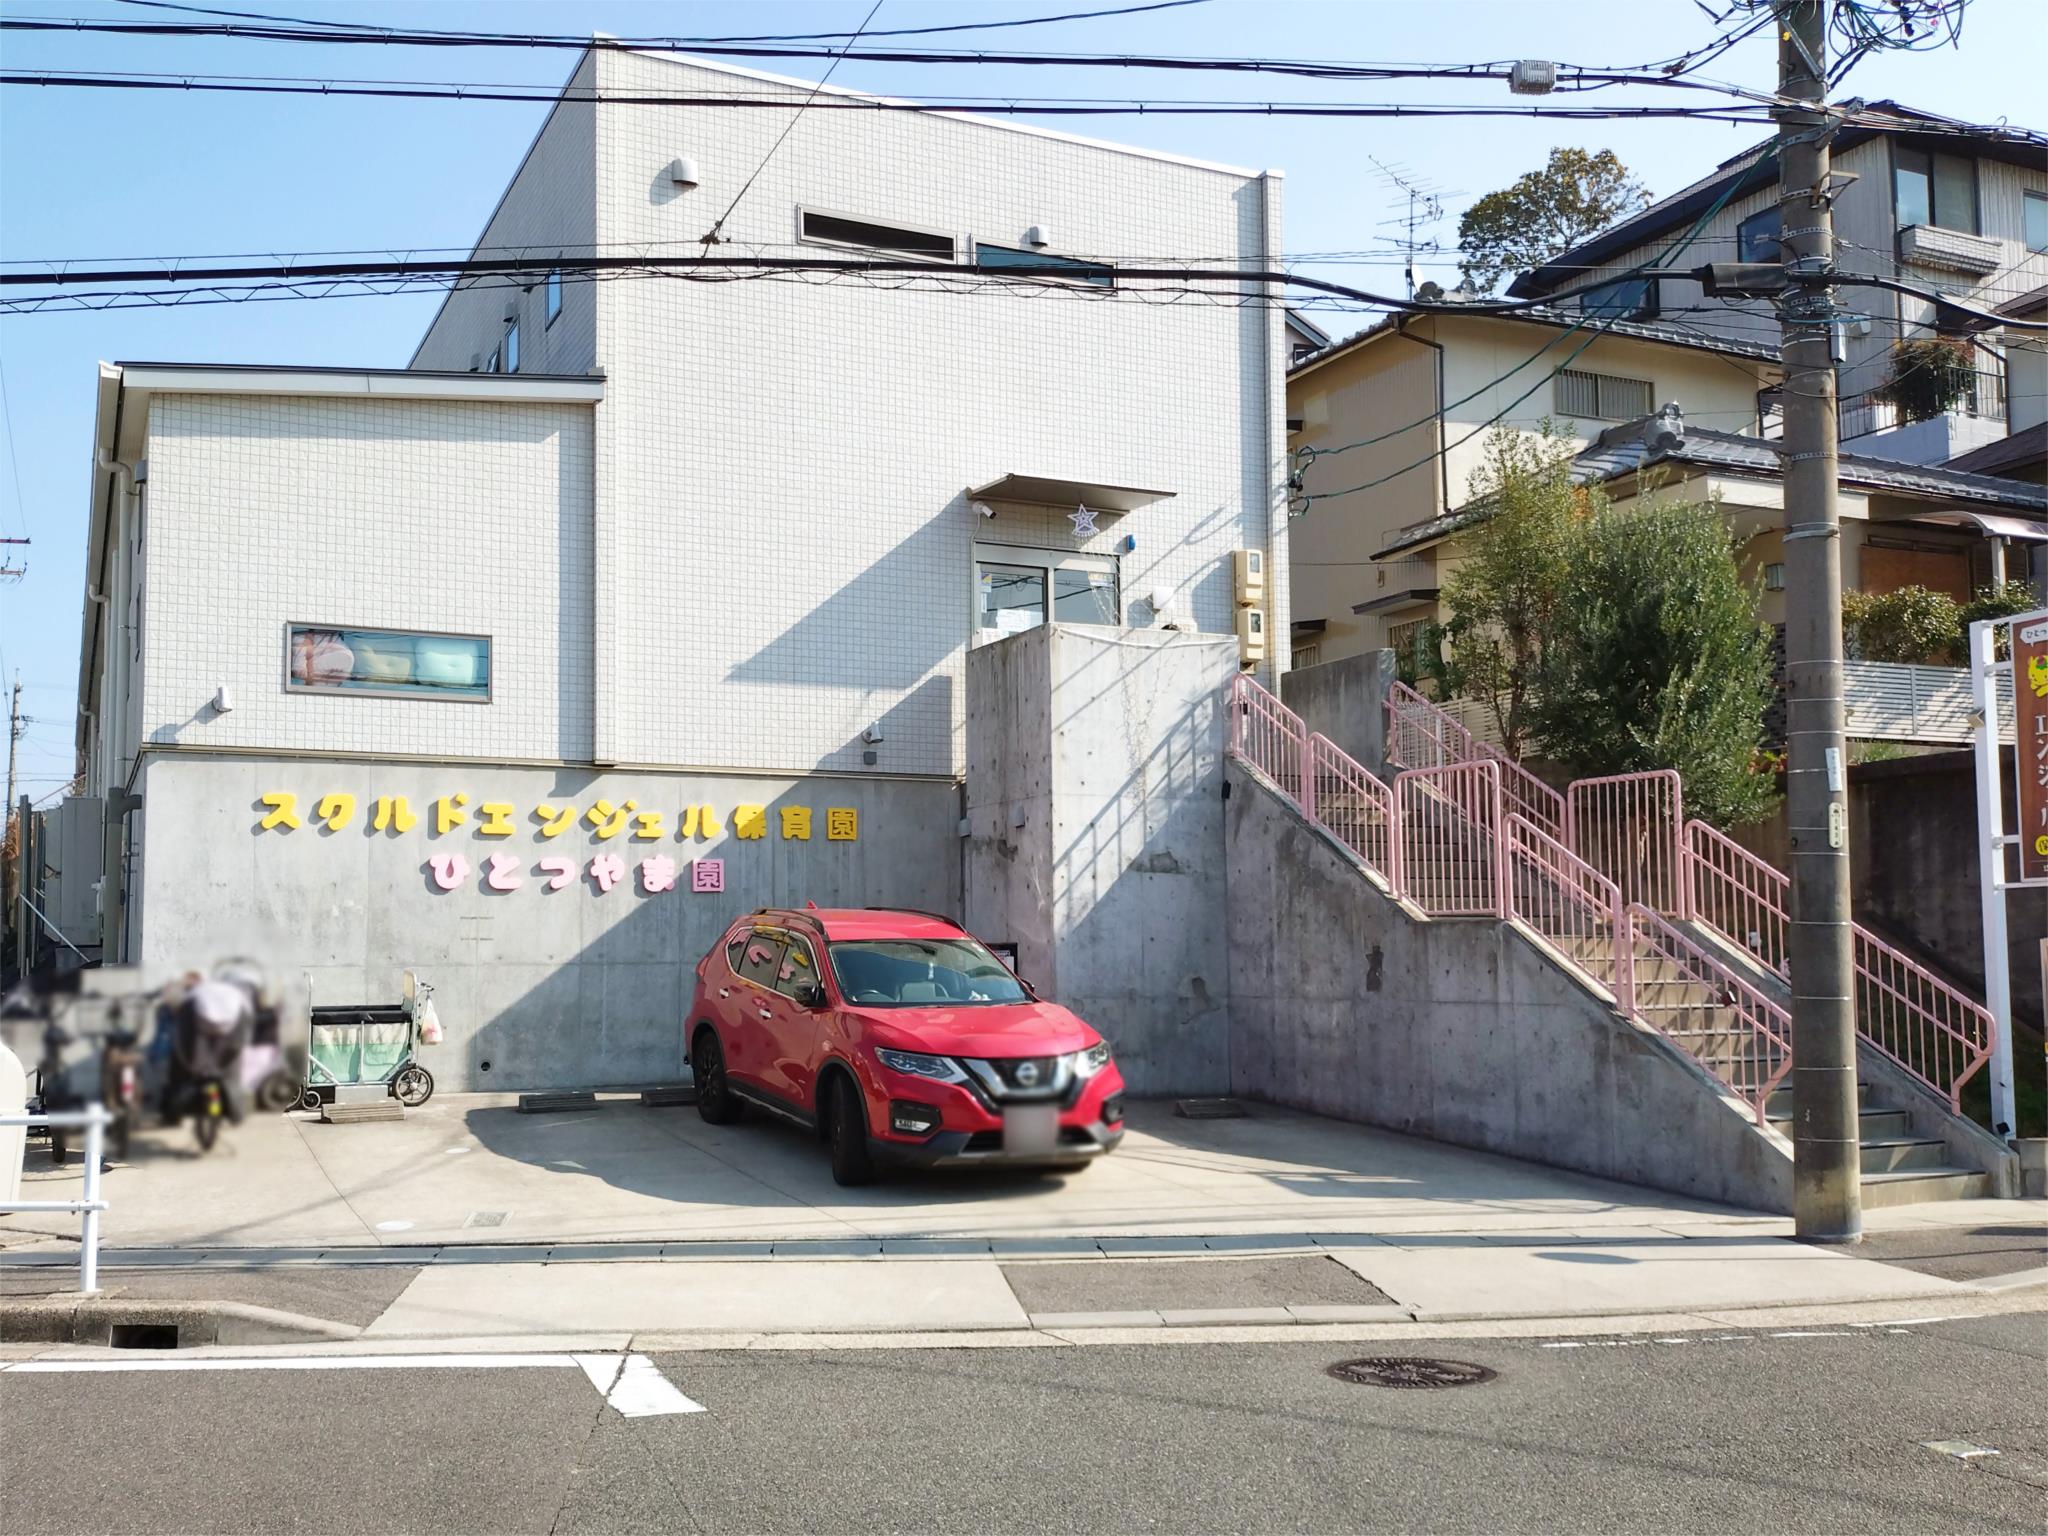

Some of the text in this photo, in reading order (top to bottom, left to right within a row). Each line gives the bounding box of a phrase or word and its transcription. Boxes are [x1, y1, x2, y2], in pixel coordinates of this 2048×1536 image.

[261, 792, 858, 841] スクルドエンジェル保育園
[429, 854, 725, 893] ひとつやま園
